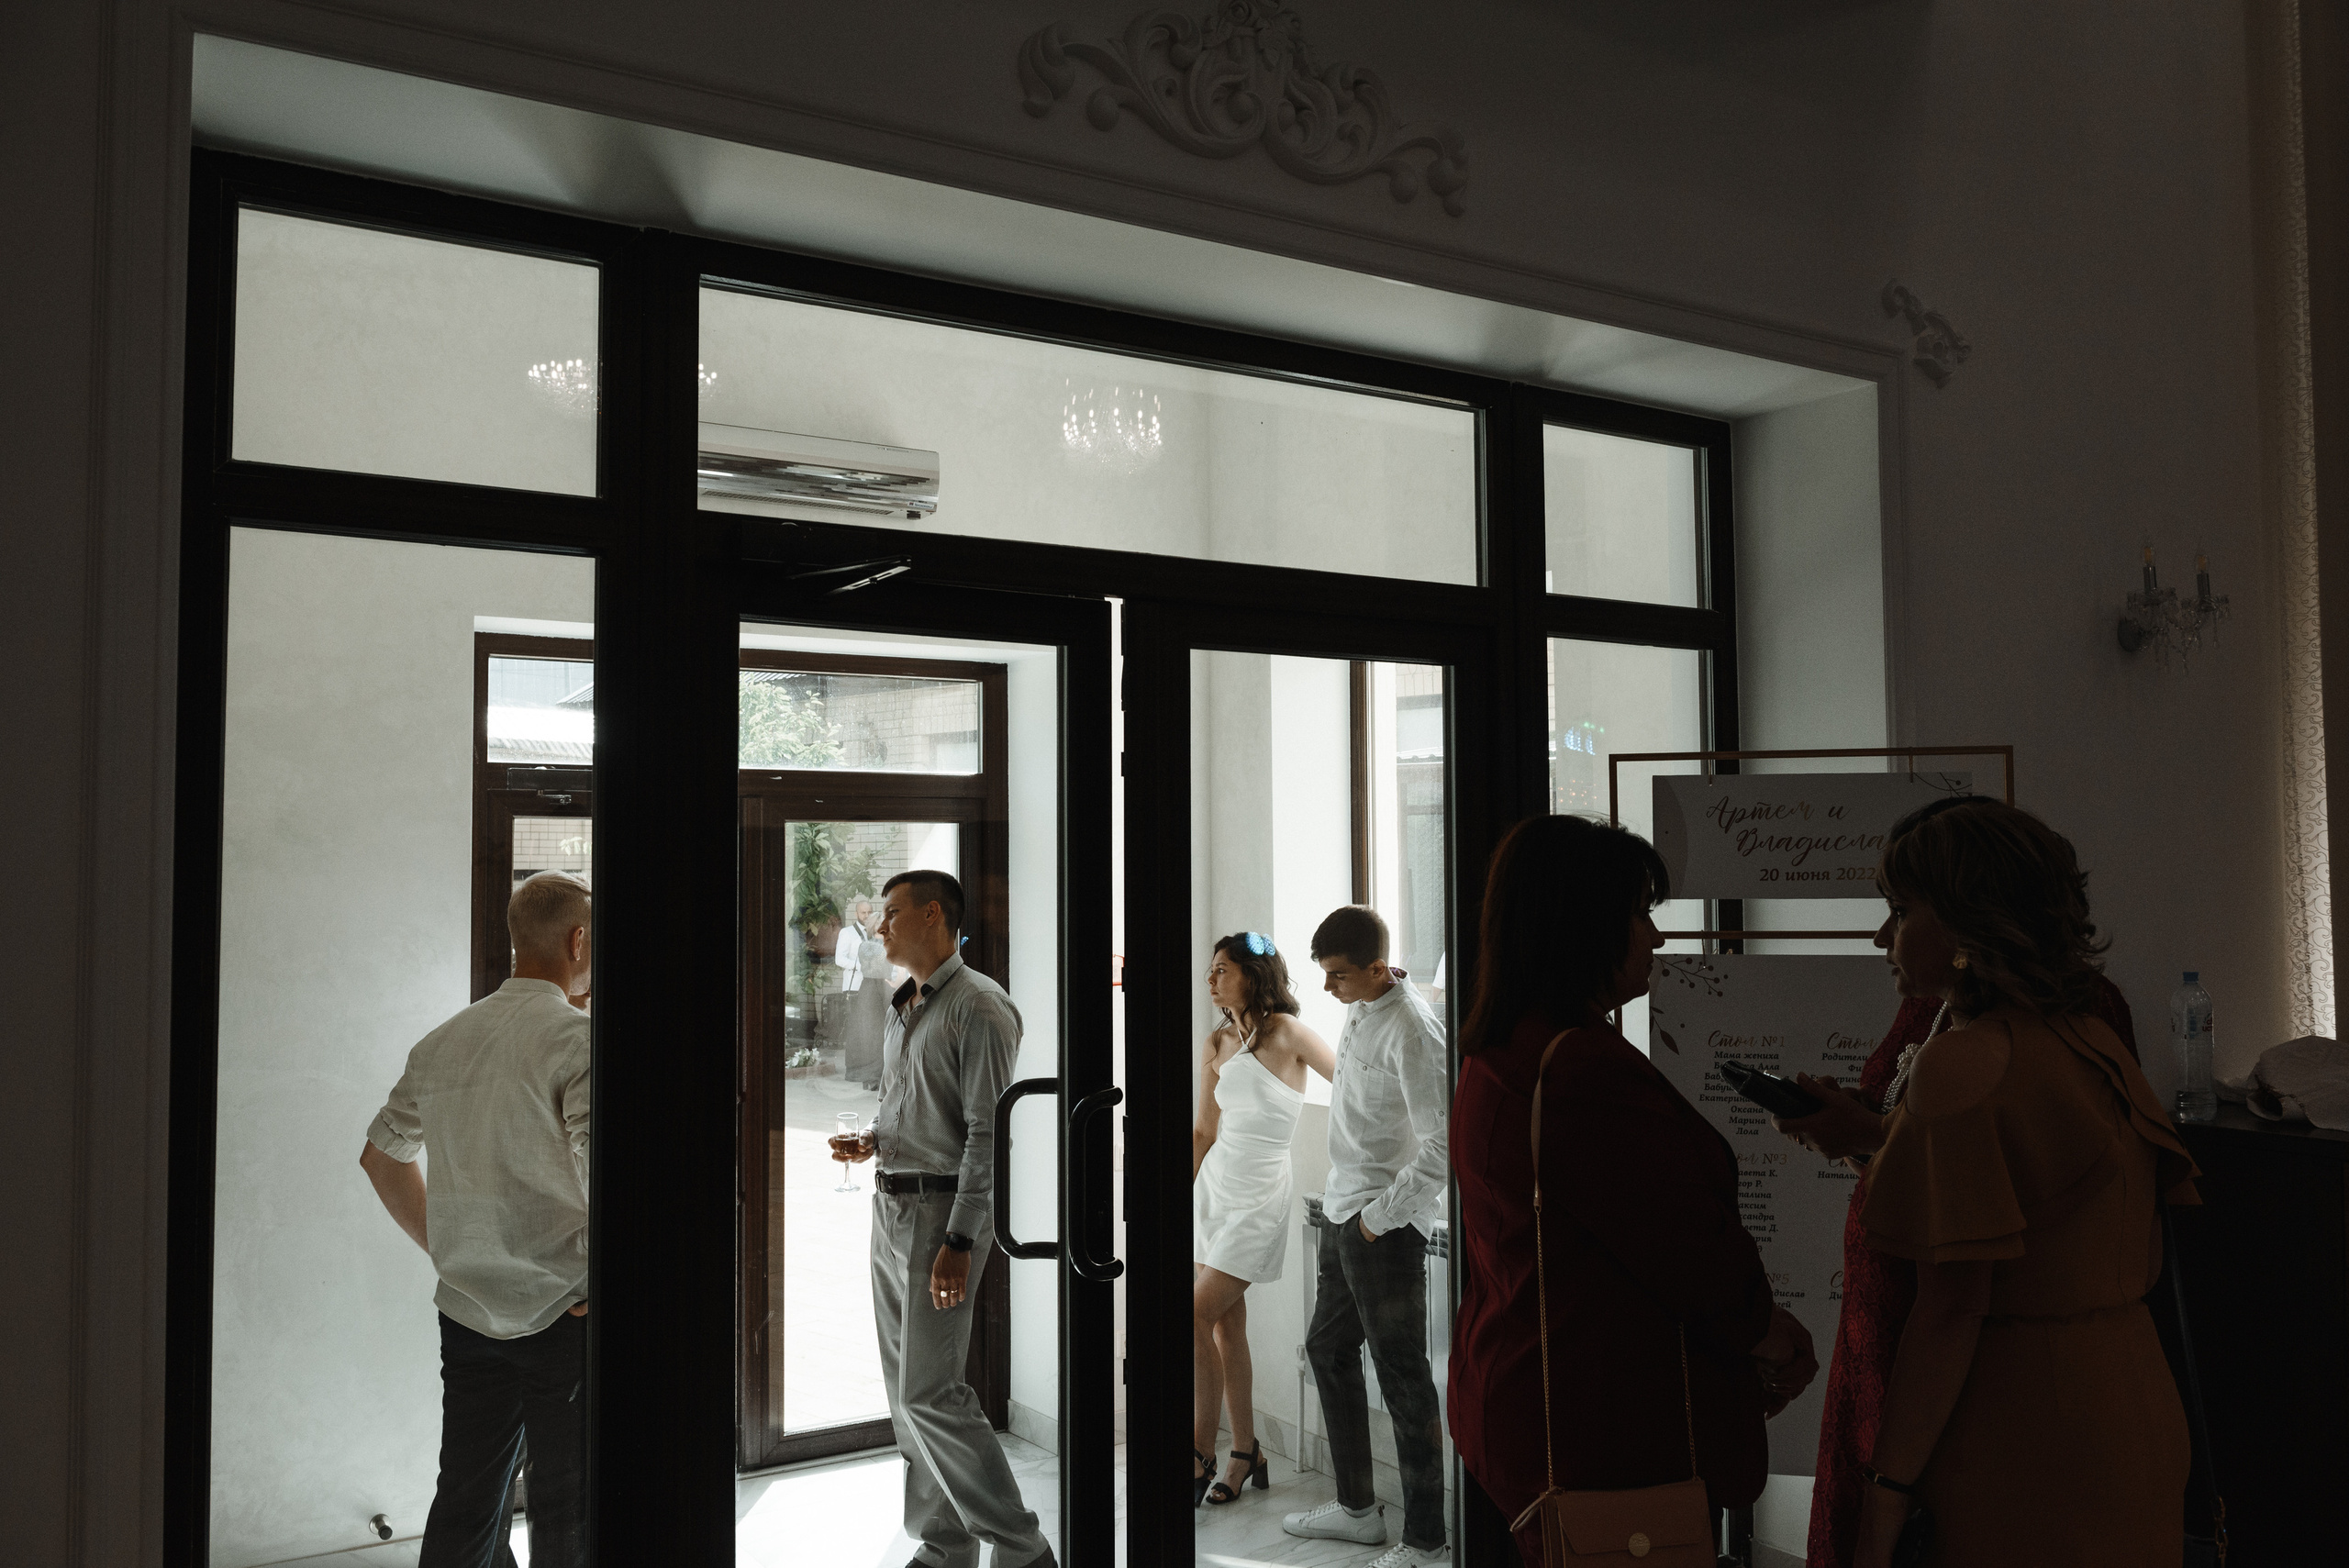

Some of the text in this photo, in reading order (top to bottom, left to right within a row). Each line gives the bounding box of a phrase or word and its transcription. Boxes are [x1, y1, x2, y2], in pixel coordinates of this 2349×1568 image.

[1706, 795, 1852, 834] Артем и
[1736, 828, 1889, 866] Владисла
[1759, 867, 1876, 881] 20 июня 2022
[1708, 1030, 1757, 1048] Стол
[1826, 1032, 1877, 1050] Стол
[1714, 1051, 1741, 1059] Мама
[1821, 1052, 1868, 1062] Родители
[1729, 1117, 1766, 1125] Марина
[1741, 1212, 1775, 1222] сандра
[1772, 1289, 1805, 1297] дислав
